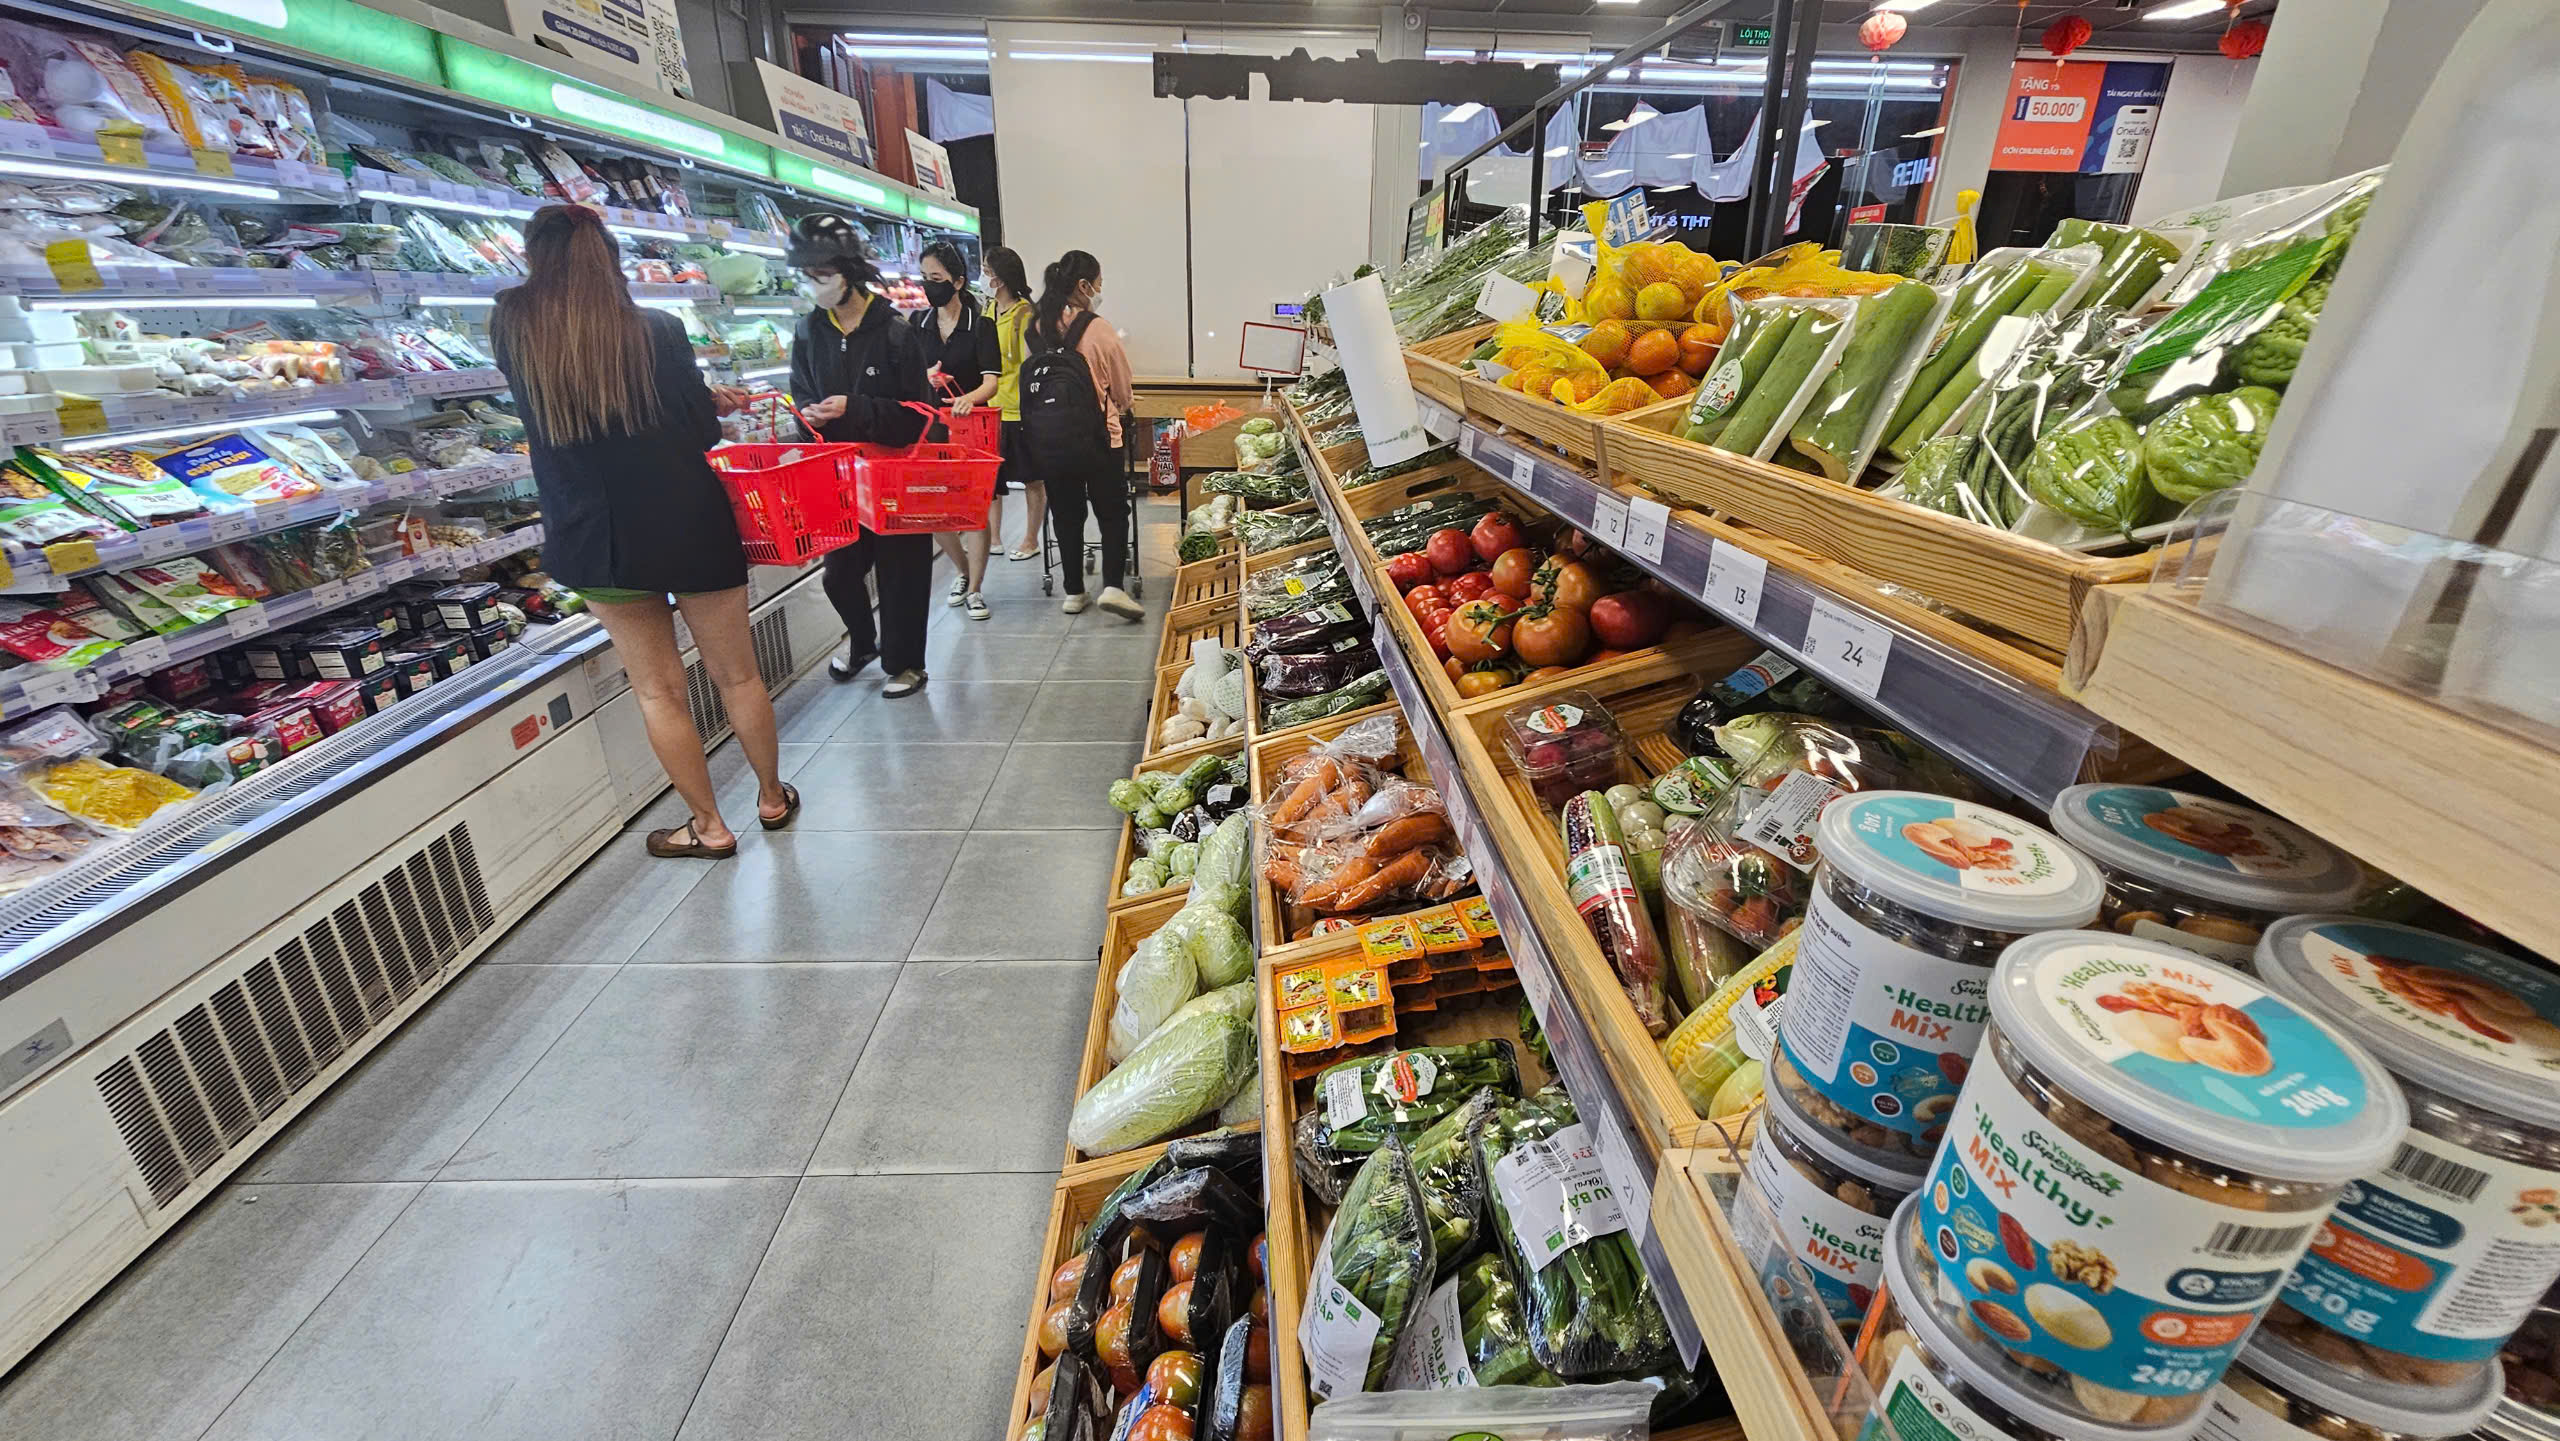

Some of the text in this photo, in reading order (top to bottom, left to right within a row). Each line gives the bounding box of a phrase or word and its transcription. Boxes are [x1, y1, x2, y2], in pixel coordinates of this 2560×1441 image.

[2020, 77, 2049, 92] TẶNG
[810, 130, 834, 148] OneLife
[2116, 127, 2151, 136] OneLife
[1644, 531, 1655, 547] 27
[161, 560, 194, 573] KIMCHI
[1735, 586, 1747, 605] 13
[5, 619, 51, 636] KIMCHI
[1841, 640, 1863, 668] 24
[2062, 959, 2214, 992] Healthy Mix
[1897, 988, 1991, 1024] Health
[1889, 1009, 1952, 1042] Mix
[2280, 1085, 2350, 1117] 240g
[1969, 1135, 2017, 1199] Mix
[1979, 1113, 2094, 1226] Healthy
[2022, 1130, 2115, 1198] Superfood
[1806, 1237, 1859, 1274] Mix
[2285, 1268, 2383, 1334] 240g
[1437, 1363, 1452, 1388] BẮ
[2131, 1365, 2214, 1391] 240g
